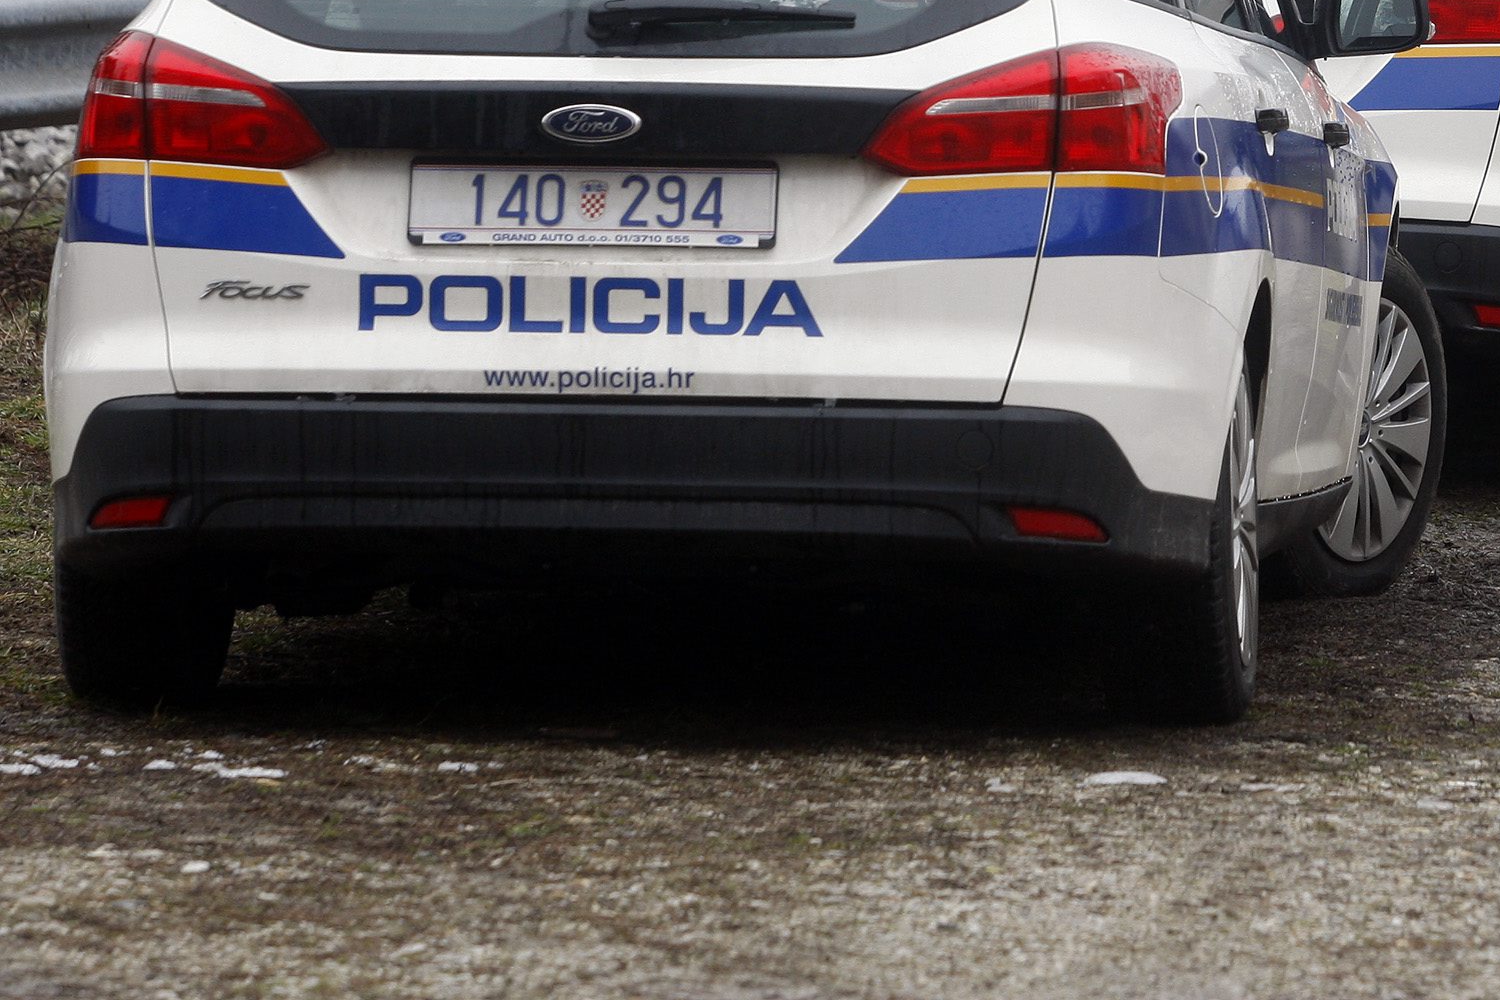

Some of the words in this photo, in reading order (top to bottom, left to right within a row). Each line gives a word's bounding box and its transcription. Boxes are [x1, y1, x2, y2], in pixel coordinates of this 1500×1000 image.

[562, 109, 619, 134] Ford
[472, 173, 566, 227] 140
[619, 174, 724, 229] 294
[492, 233, 536, 242] GRAND
[539, 233, 574, 242] AUTO
[577, 233, 611, 243] d.o.o.
[615, 234, 662, 244] 01/3710
[666, 234, 690, 244] 555
[358, 273, 824, 338] POLICIJA
[484, 367, 695, 394] www.policija.hr
